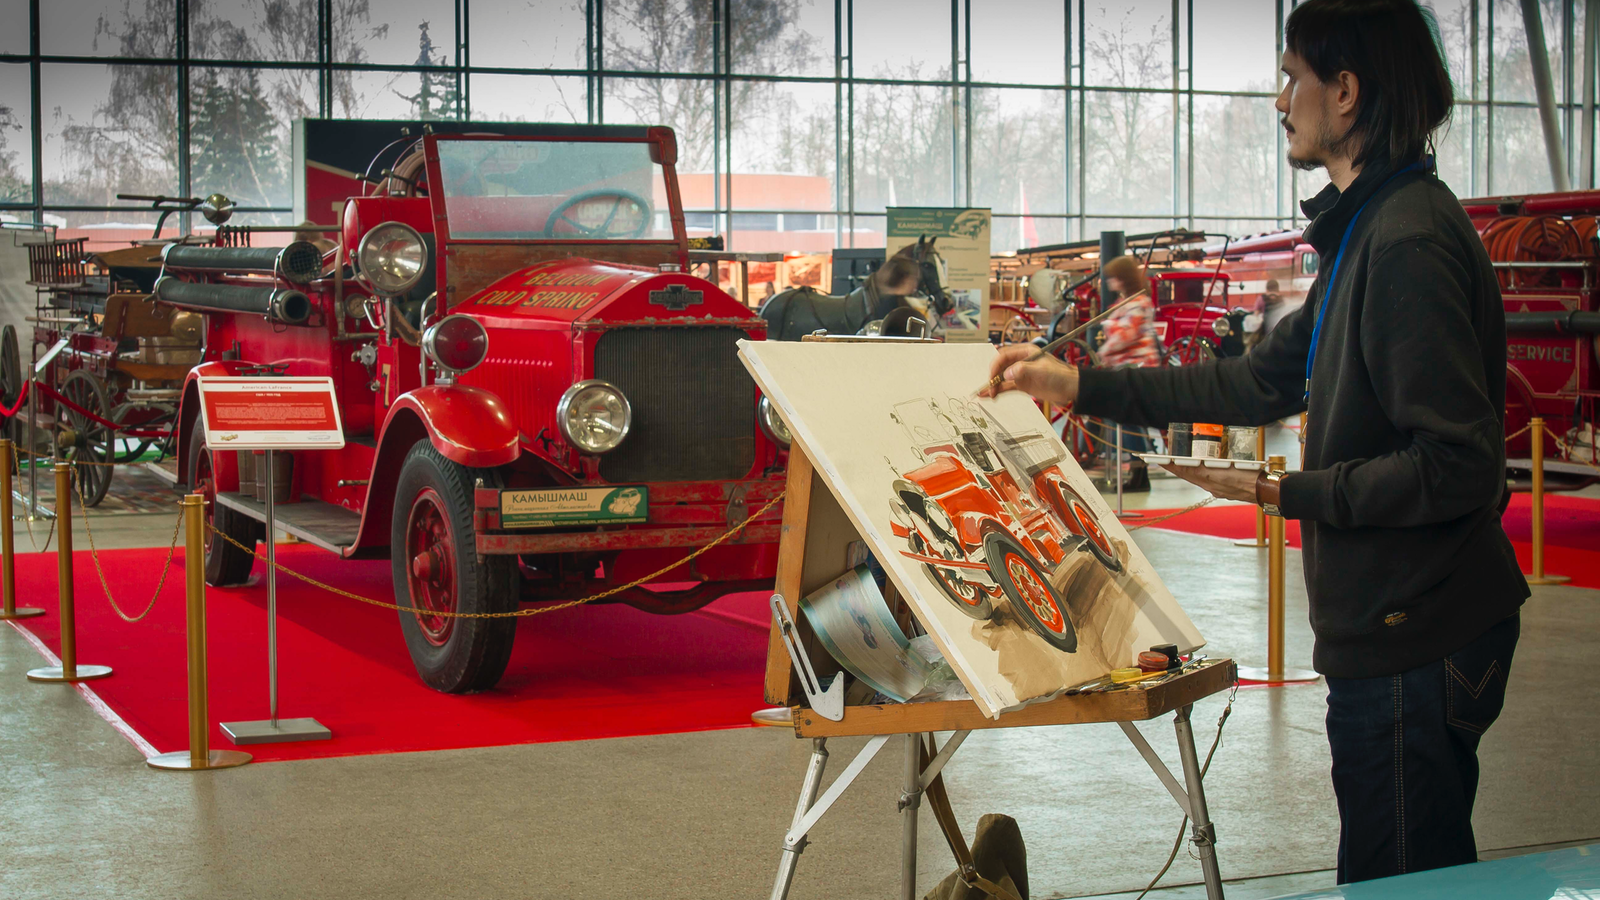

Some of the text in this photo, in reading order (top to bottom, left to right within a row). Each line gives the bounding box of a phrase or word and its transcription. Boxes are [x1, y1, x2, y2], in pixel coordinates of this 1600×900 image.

[521, 272, 611, 287] BELGIUM
[476, 290, 599, 310] COLD SPRING
[1507, 345, 1572, 362] SERVICE
[512, 492, 587, 503] КАМЫШМАШ
